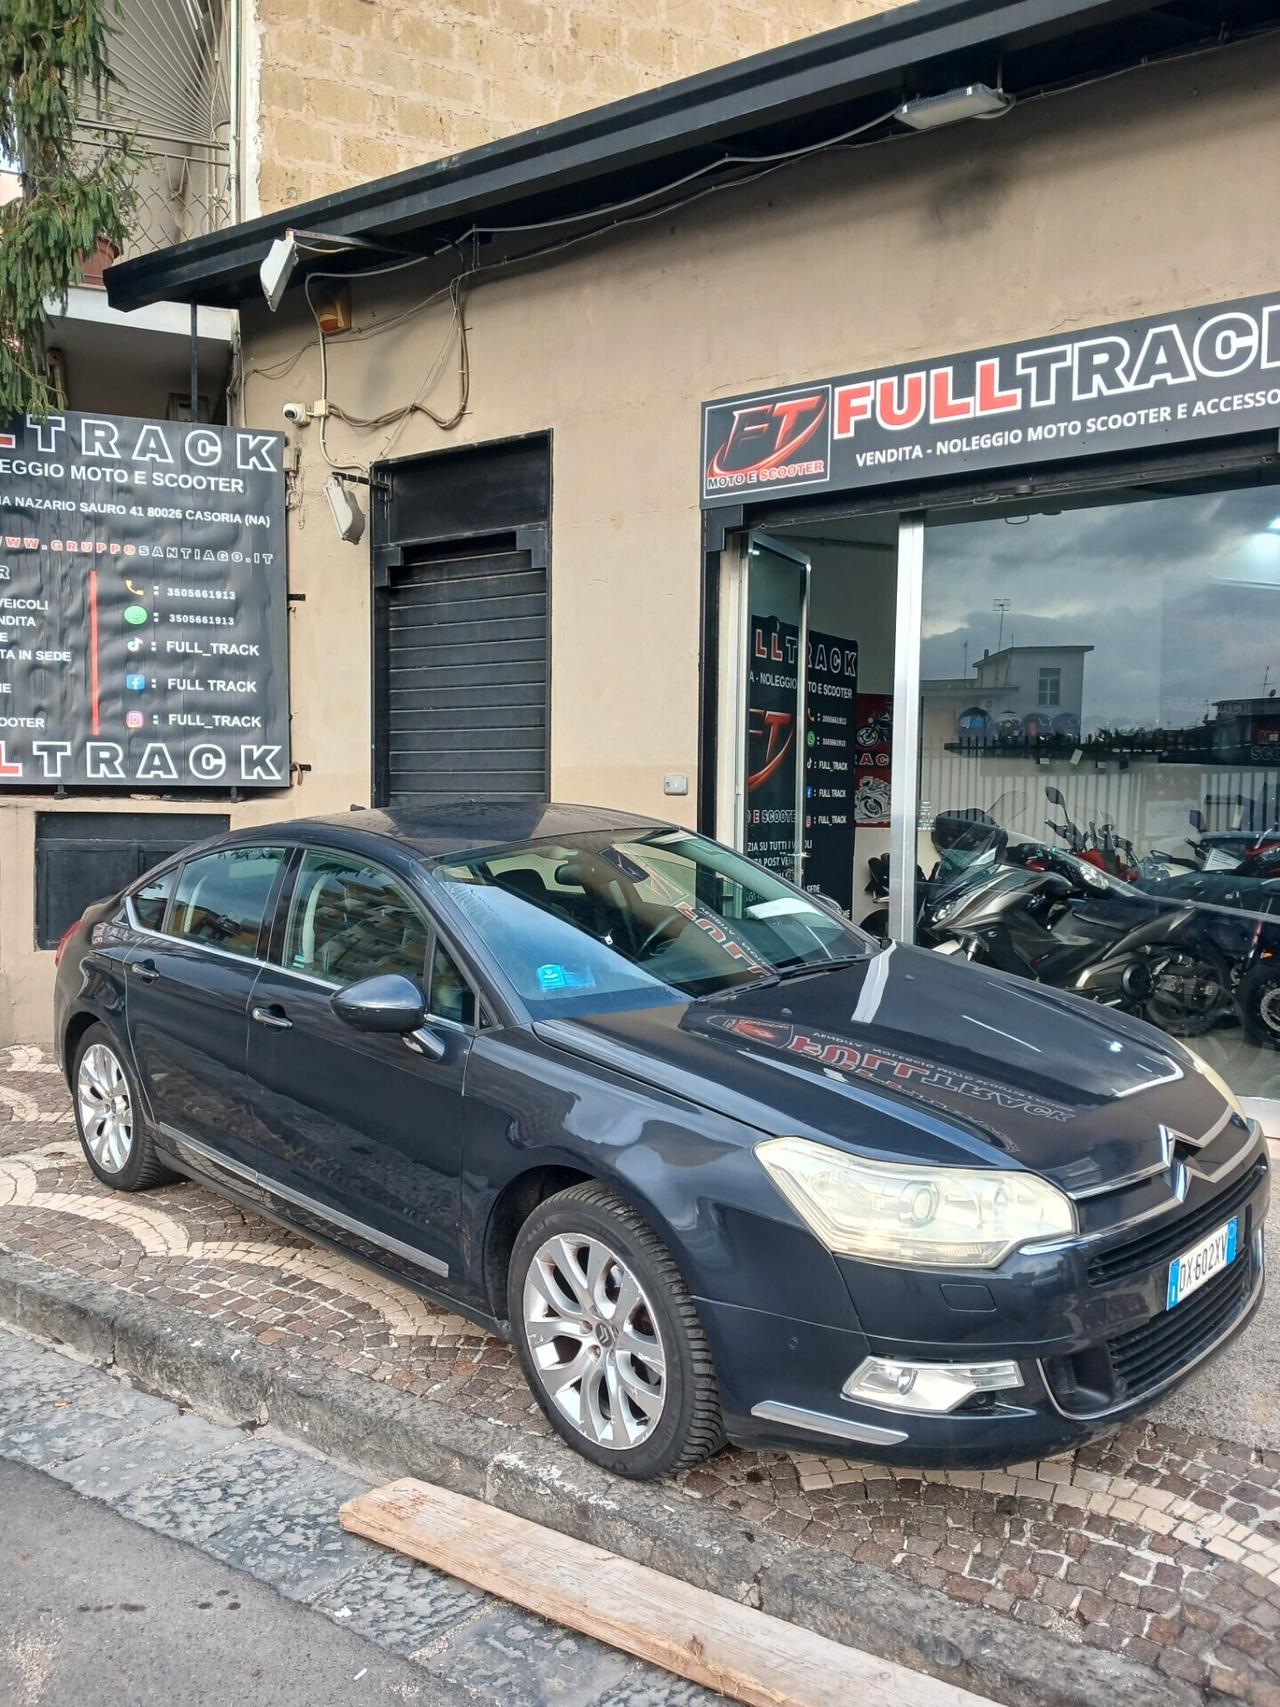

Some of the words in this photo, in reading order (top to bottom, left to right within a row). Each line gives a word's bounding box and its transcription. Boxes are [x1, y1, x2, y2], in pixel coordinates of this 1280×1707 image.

[855, 446, 924, 467] VENDITA
[935, 427, 1022, 455] NOLEGGIO
[1028, 419, 1082, 441] MOTO
[1086, 406, 1172, 433] SCOOTER
[1177, 403, 1188, 420] E
[70, 465, 129, 485] MOTO
[134, 470, 147, 485] E
[152, 472, 244, 493] SCOOTER
[707, 473, 745, 490] MOTO
[748, 471, 757, 484] E
[759, 459, 824, 481] SCOOTER
[15, 496, 76, 512] NAZARIO
[79, 502, 126, 516] SAURO
[130, 506, 144, 517] 41
[147, 507, 182, 519] 80026
[185, 509, 242, 523] CASORIA
[245, 513, 270, 528] (NA)
[0, 535, 274, 566] WW.GRUPPOSANTIAGO.IT
[167, 587, 236, 600] 3505661913
[0, 598, 49, 611] EICOLI
[169, 614, 234, 626] 3505661913
[166, 640, 260, 656] FULL_TRACK
[19, 650, 32, 660] IN
[35, 651, 72, 662] SEDE
[167, 678, 204, 691] FULL
[208, 679, 257, 693] TRACK
[760, 672, 797, 690] NOLEGGIO
[818, 683, 822, 695] E
[823, 684, 853, 699] SCOOTER
[168, 714, 261, 729] FULL_TRACK
[818, 789, 831, 798] FULL
[832, 789, 847, 798] TRACK
[760, 841, 768, 851] SU
[769, 840, 787, 850] TUTTI
[763, 857, 780, 867] POST
